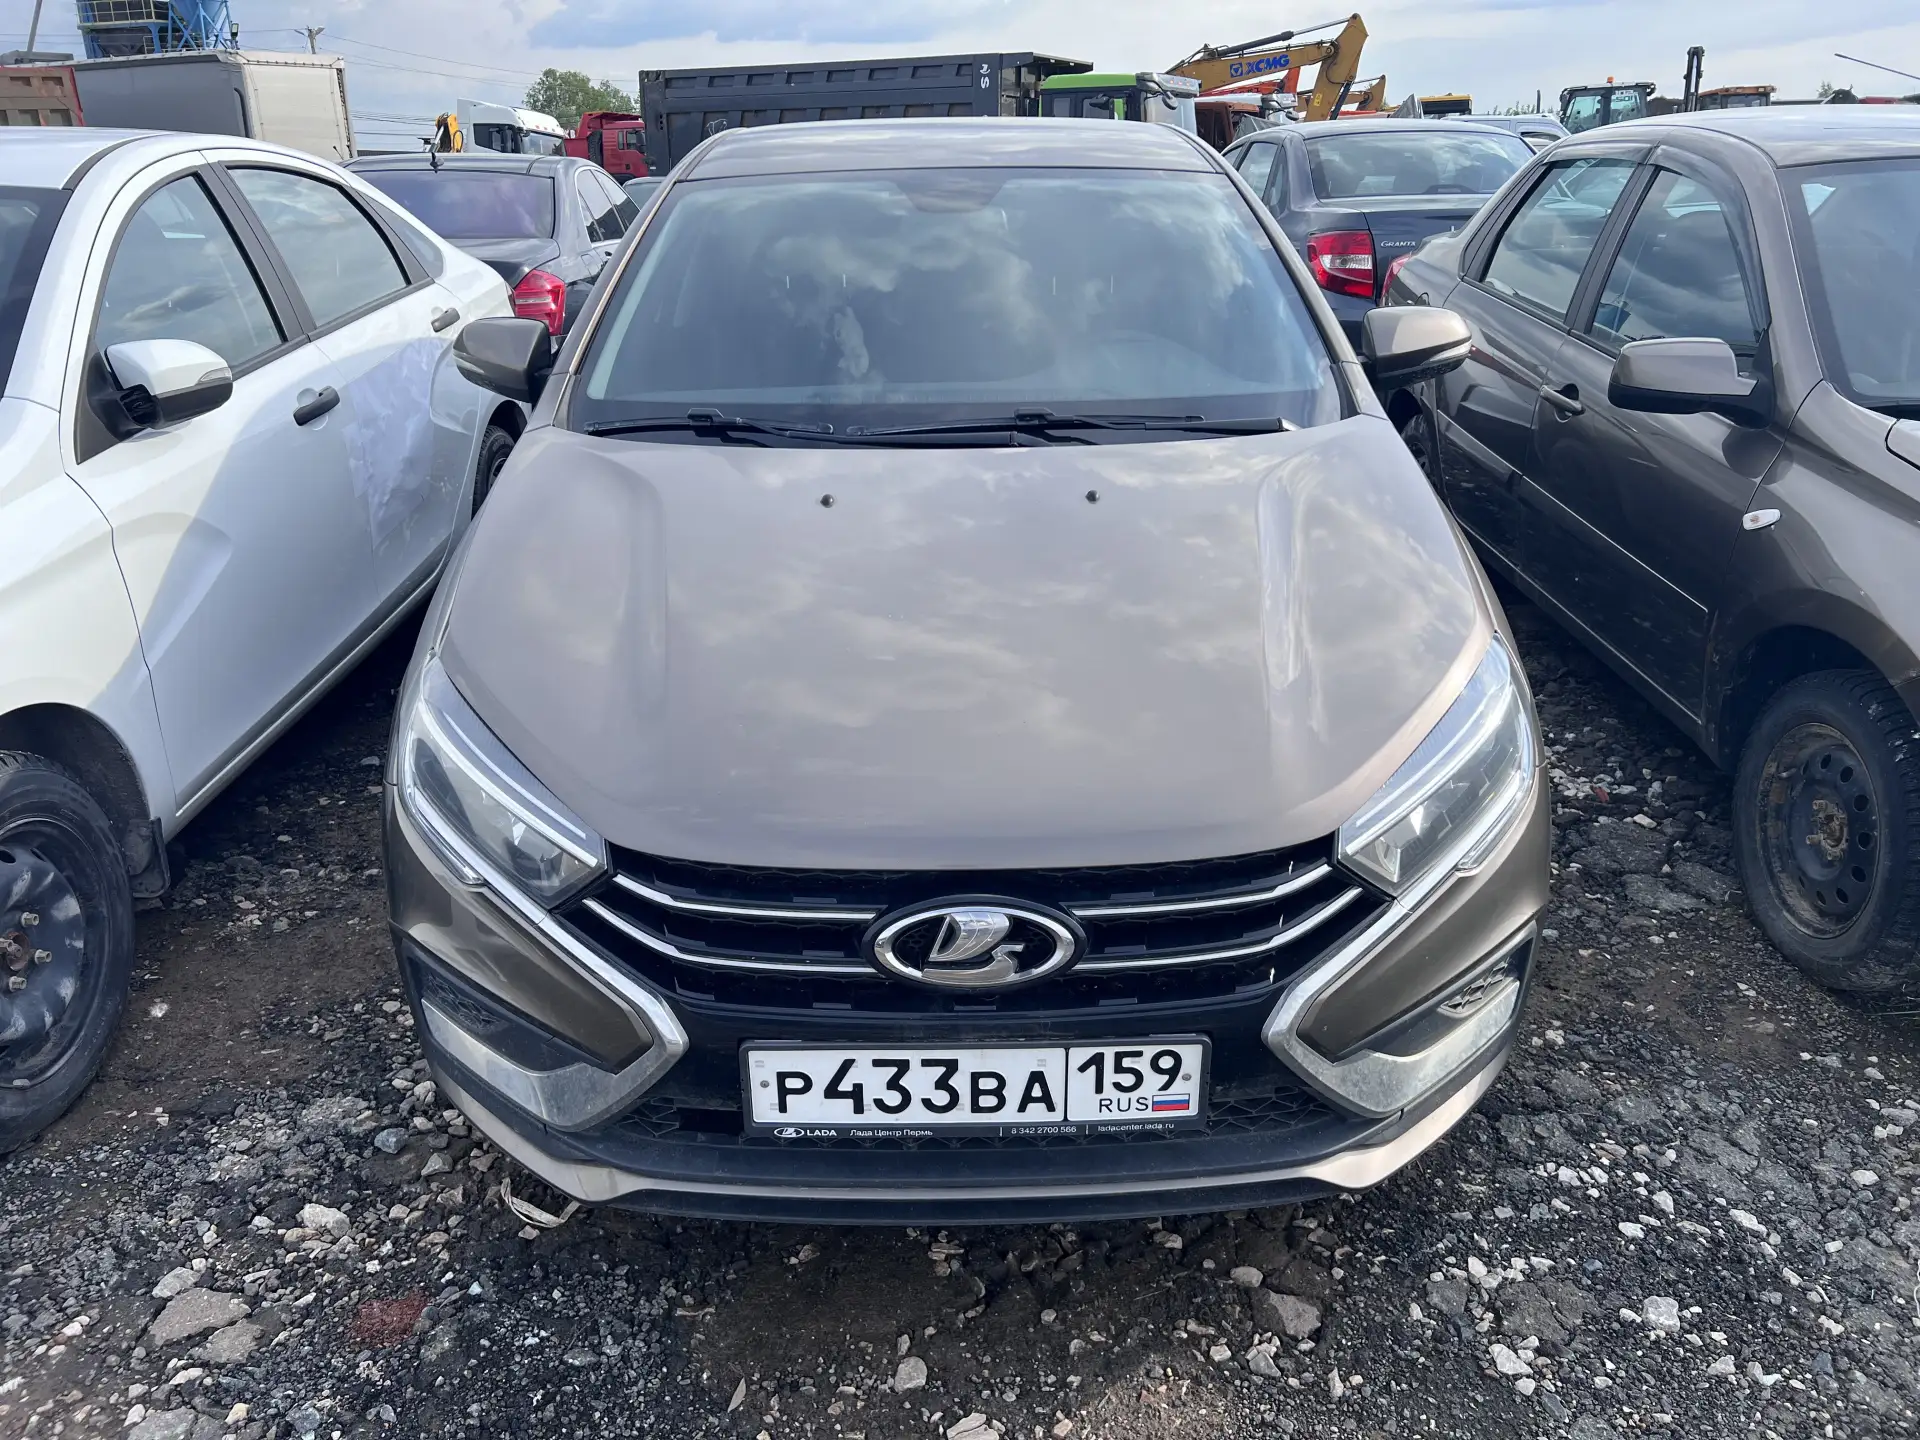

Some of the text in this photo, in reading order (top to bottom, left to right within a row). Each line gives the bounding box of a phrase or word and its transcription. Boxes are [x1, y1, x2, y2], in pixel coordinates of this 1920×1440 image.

[1244, 53, 1290, 76] XCMG
[1380, 240, 1416, 248] GRANTA
[1076, 1048, 1183, 1095] 159
[1098, 1096, 1149, 1113] RUS
[1011, 1125, 1077, 1135] 8 342 2700 566
[1097, 1122, 1175, 1133] ladacenter.lada.ru
[806, 1129, 838, 1137] LADA
[850, 1129, 933, 1137] Лада Центр Пермь
